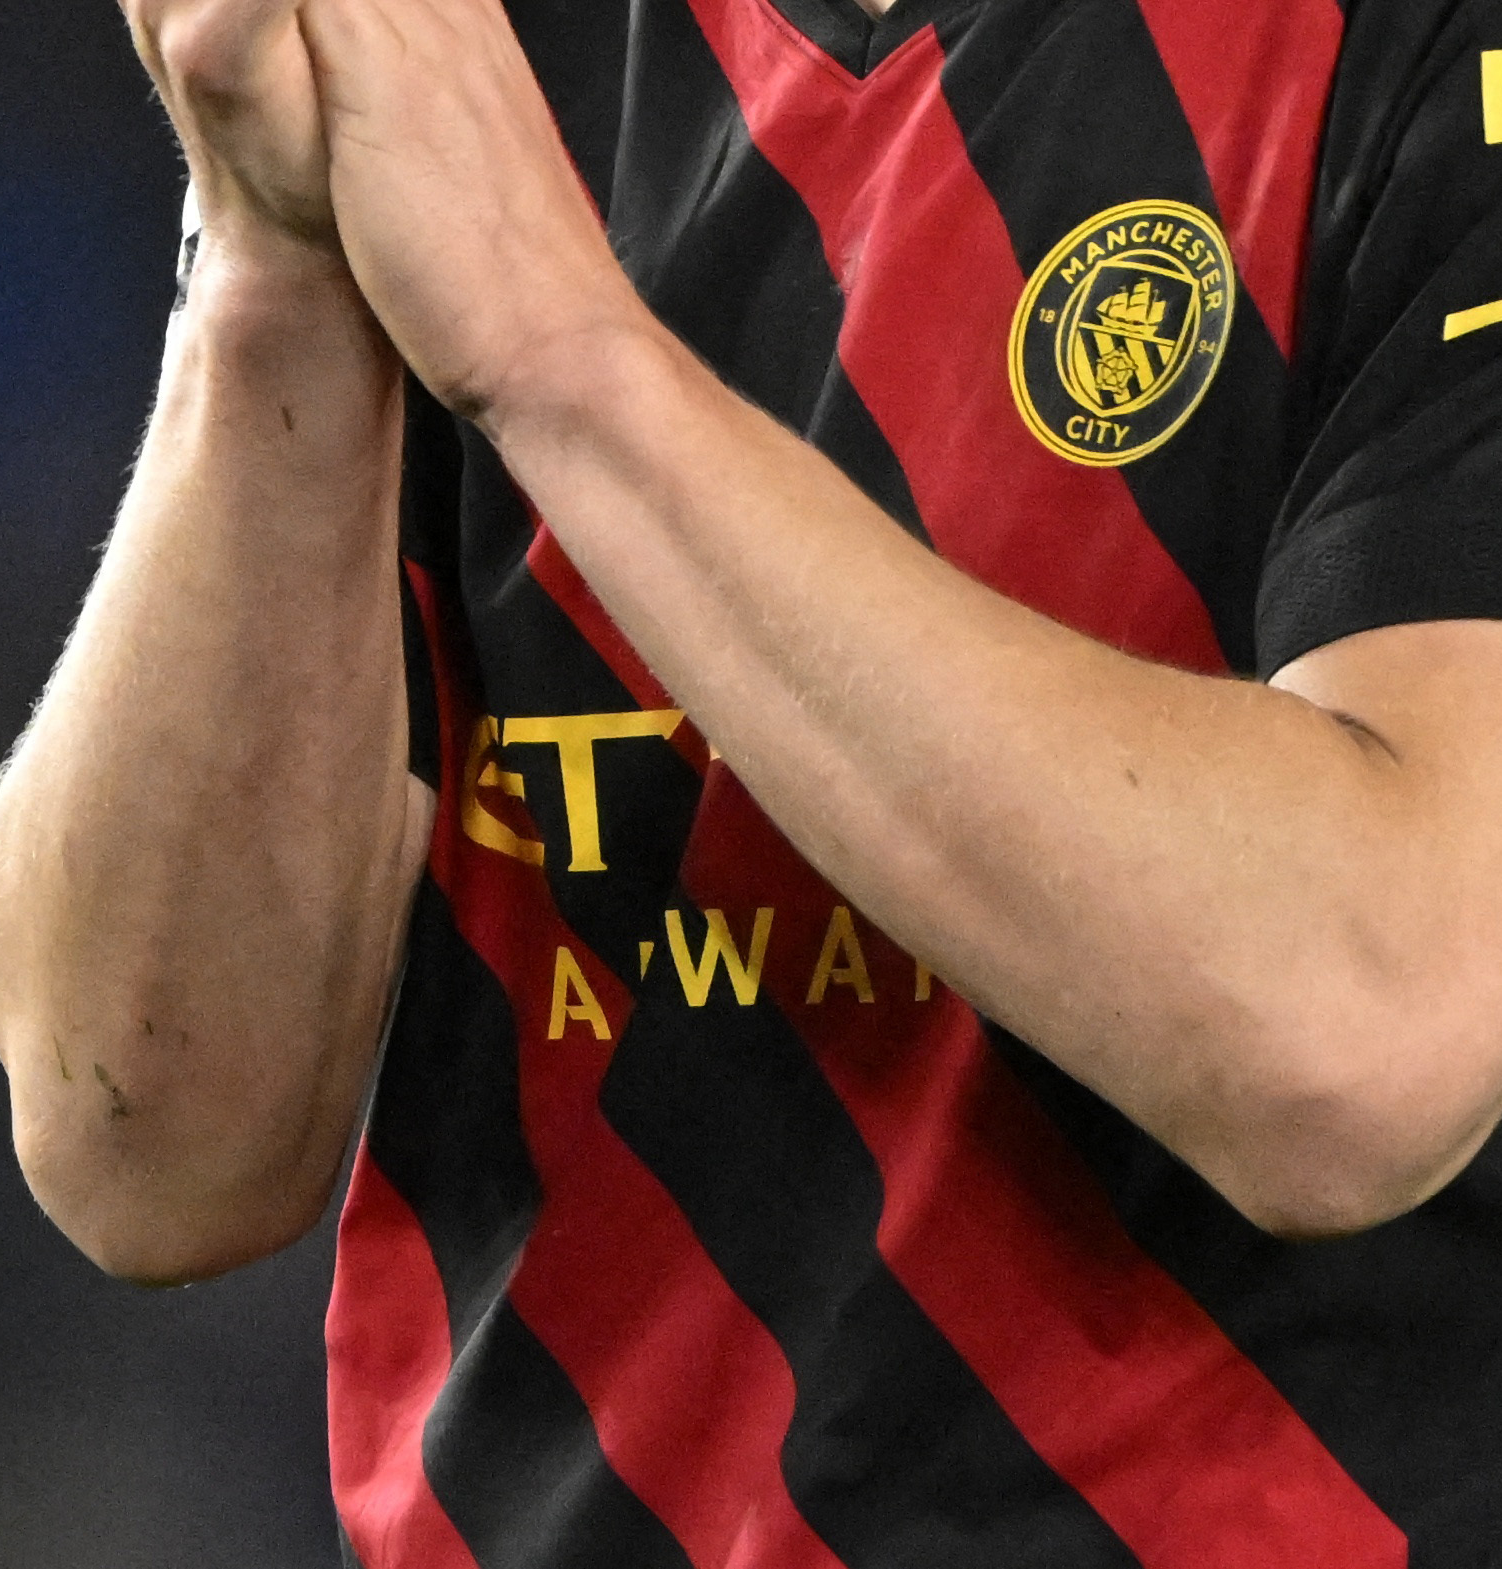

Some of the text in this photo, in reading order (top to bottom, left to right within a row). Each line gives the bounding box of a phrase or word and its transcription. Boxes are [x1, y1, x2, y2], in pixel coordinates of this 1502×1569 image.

[1059, 220, 1223, 313] MANCHESTER
[1039, 307, 1056, 323] 18
[1065, 414, 1131, 448] CITY
[461, 708, 720, 872] ET
